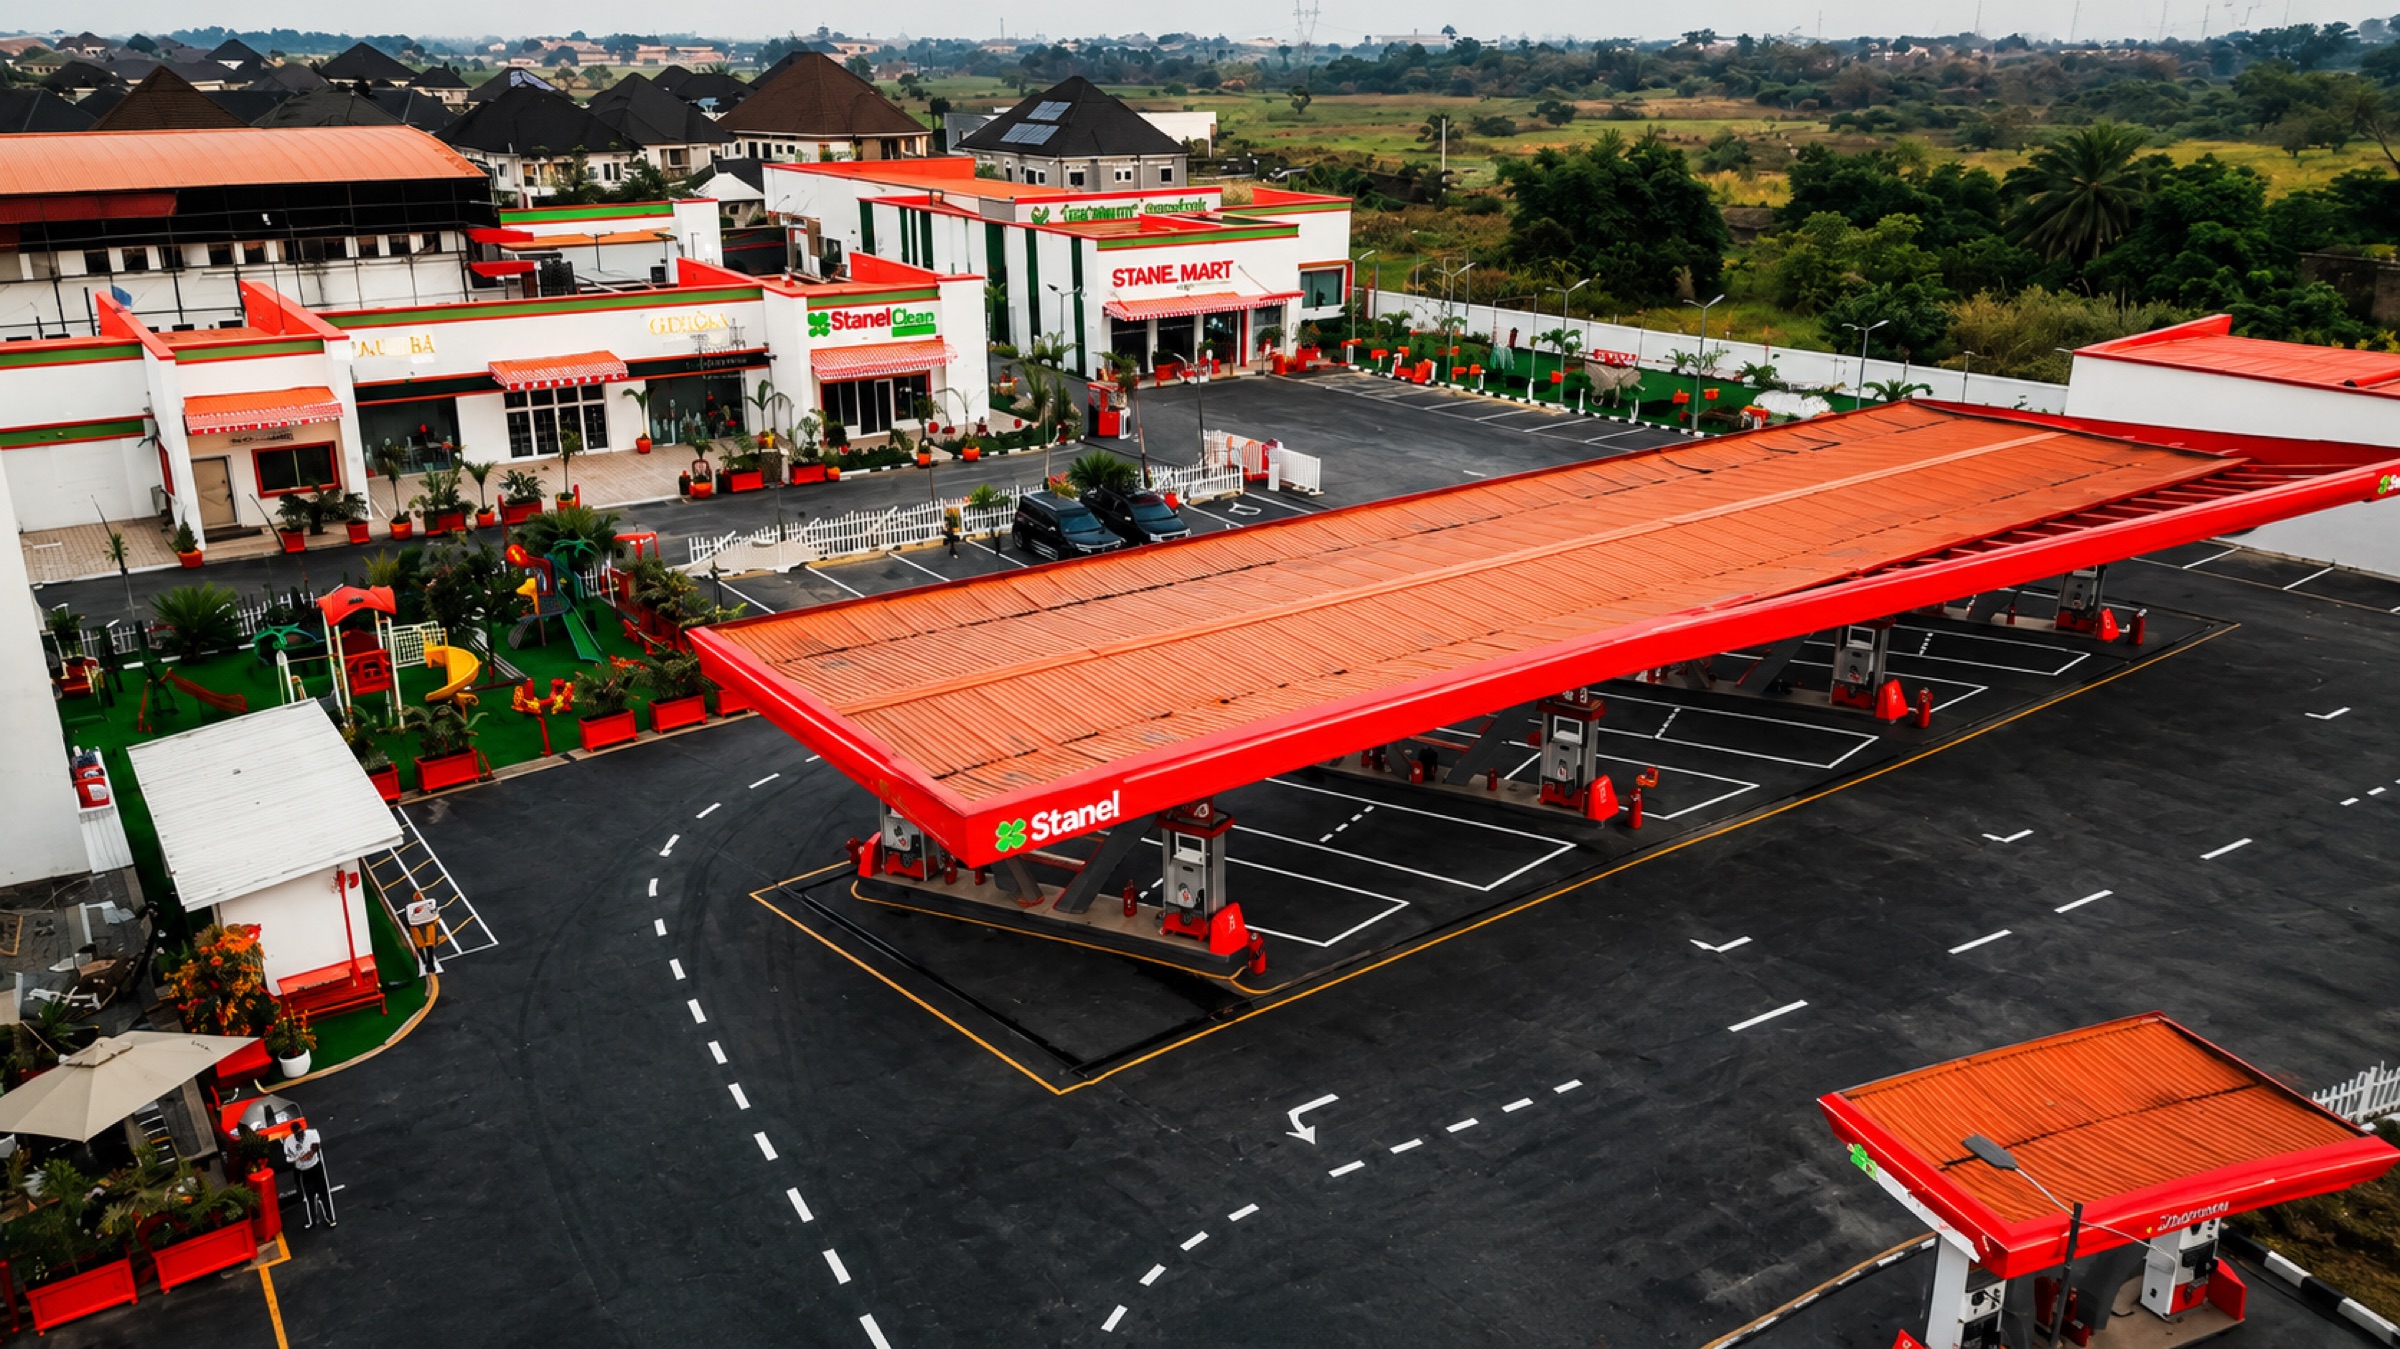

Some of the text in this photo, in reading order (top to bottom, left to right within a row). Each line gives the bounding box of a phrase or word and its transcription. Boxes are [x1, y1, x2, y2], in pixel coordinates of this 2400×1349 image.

[1181, 260, 1234, 282] MART
[831, 307, 891, 330] Stanel
[1031, 790, 1120, 841] Stanel
